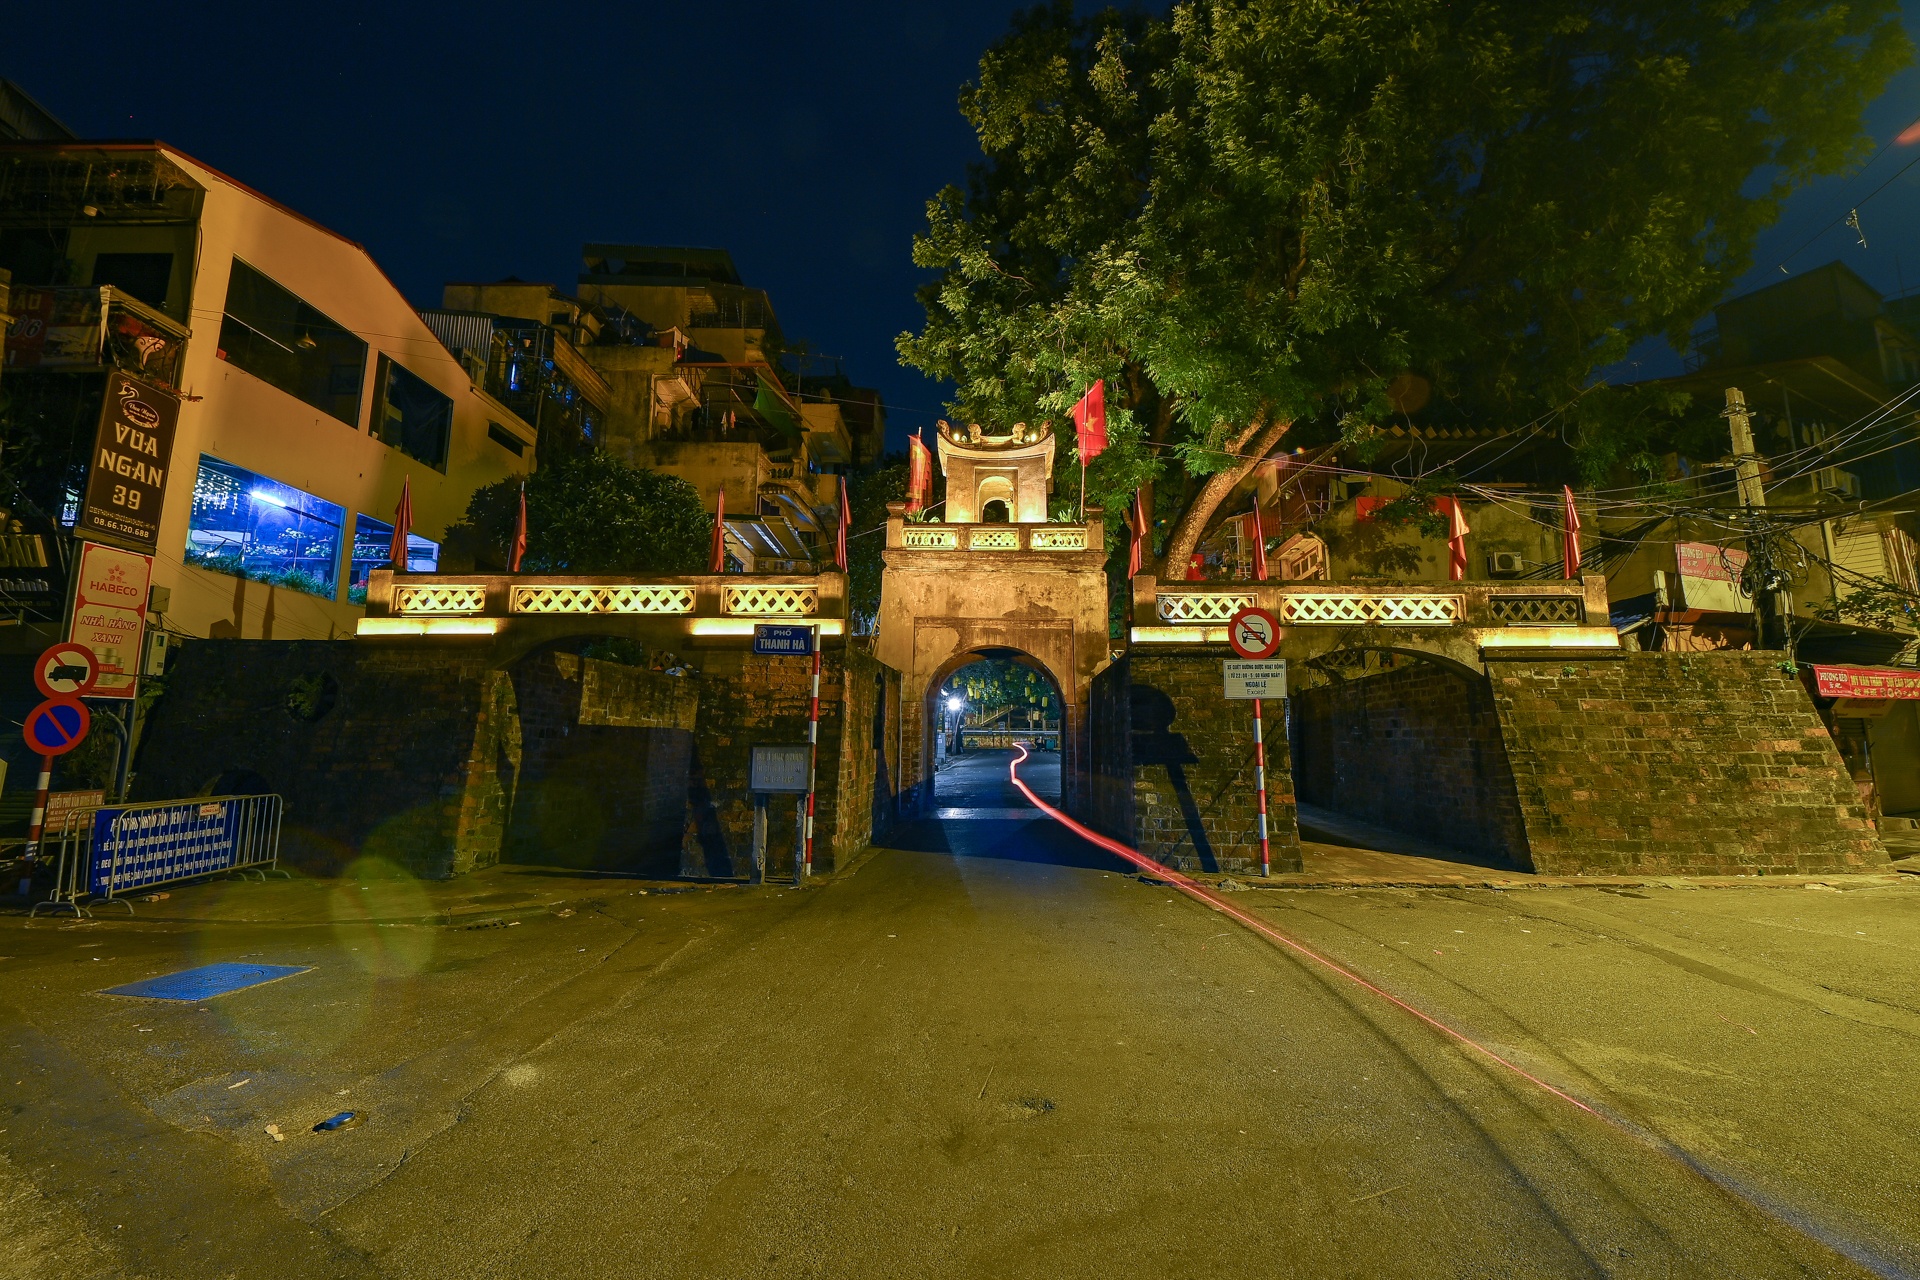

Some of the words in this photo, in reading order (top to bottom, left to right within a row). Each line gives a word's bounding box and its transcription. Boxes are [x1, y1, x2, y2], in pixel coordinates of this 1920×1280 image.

[114, 421, 158, 459] VUA
[98, 447, 164, 489] NGAN
[112, 484, 142, 511] 39
[93, 516, 150, 538] 08.66.120.688
[90, 580, 138, 597] HABECO
[80, 614, 105, 628] NHÀ
[107, 617, 137, 631] HÀNG
[92, 632, 123, 644] XANH
[773, 627, 792, 636] PHỐ
[760, 638, 790, 650] THANH
[792, 637, 805, 650] HÀ
[1261, 680, 1267, 688] LỆ
